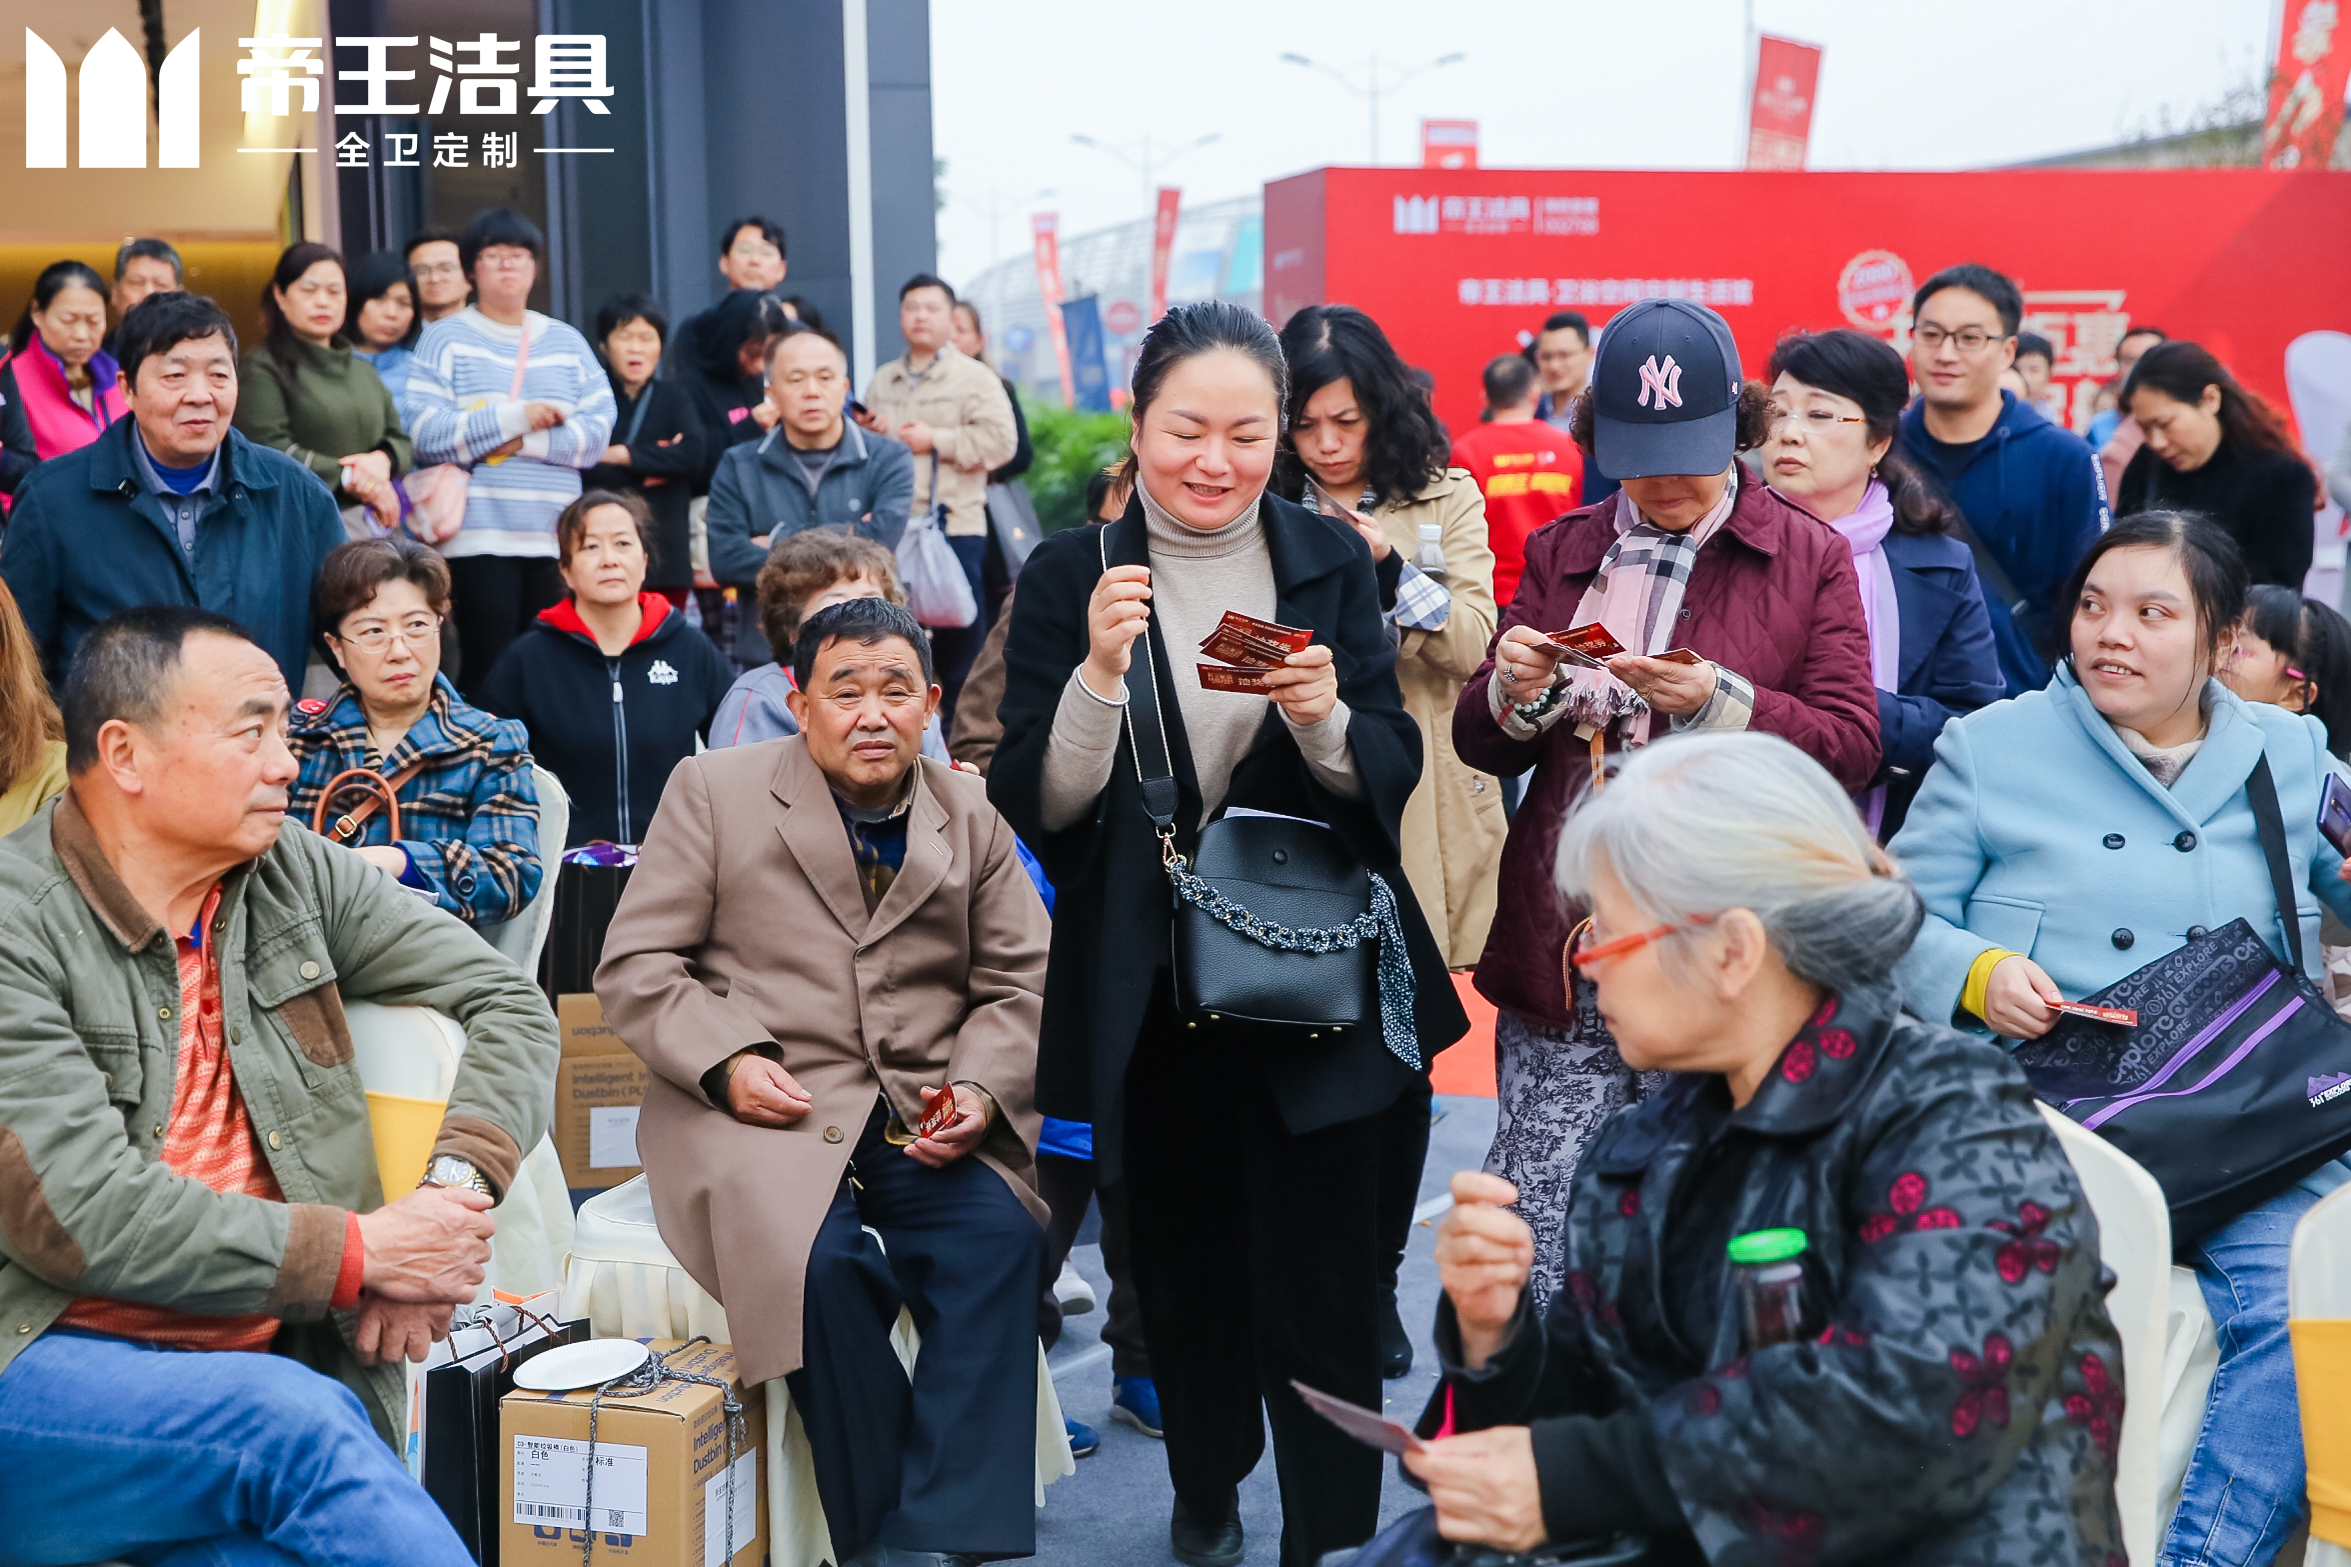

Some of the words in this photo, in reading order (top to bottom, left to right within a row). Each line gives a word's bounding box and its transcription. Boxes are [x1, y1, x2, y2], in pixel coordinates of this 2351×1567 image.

[1637, 354, 1683, 411] NY
[2174, 941, 2218, 984] EXPLORE
[2146, 1018, 2191, 1065] EXPLORE
[572, 1070, 633, 1086] Intelligent
[531, 1450, 550, 1461] 白色
[595, 1456, 615, 1467] 标准
[693, 1444, 722, 1475] Dustbin
